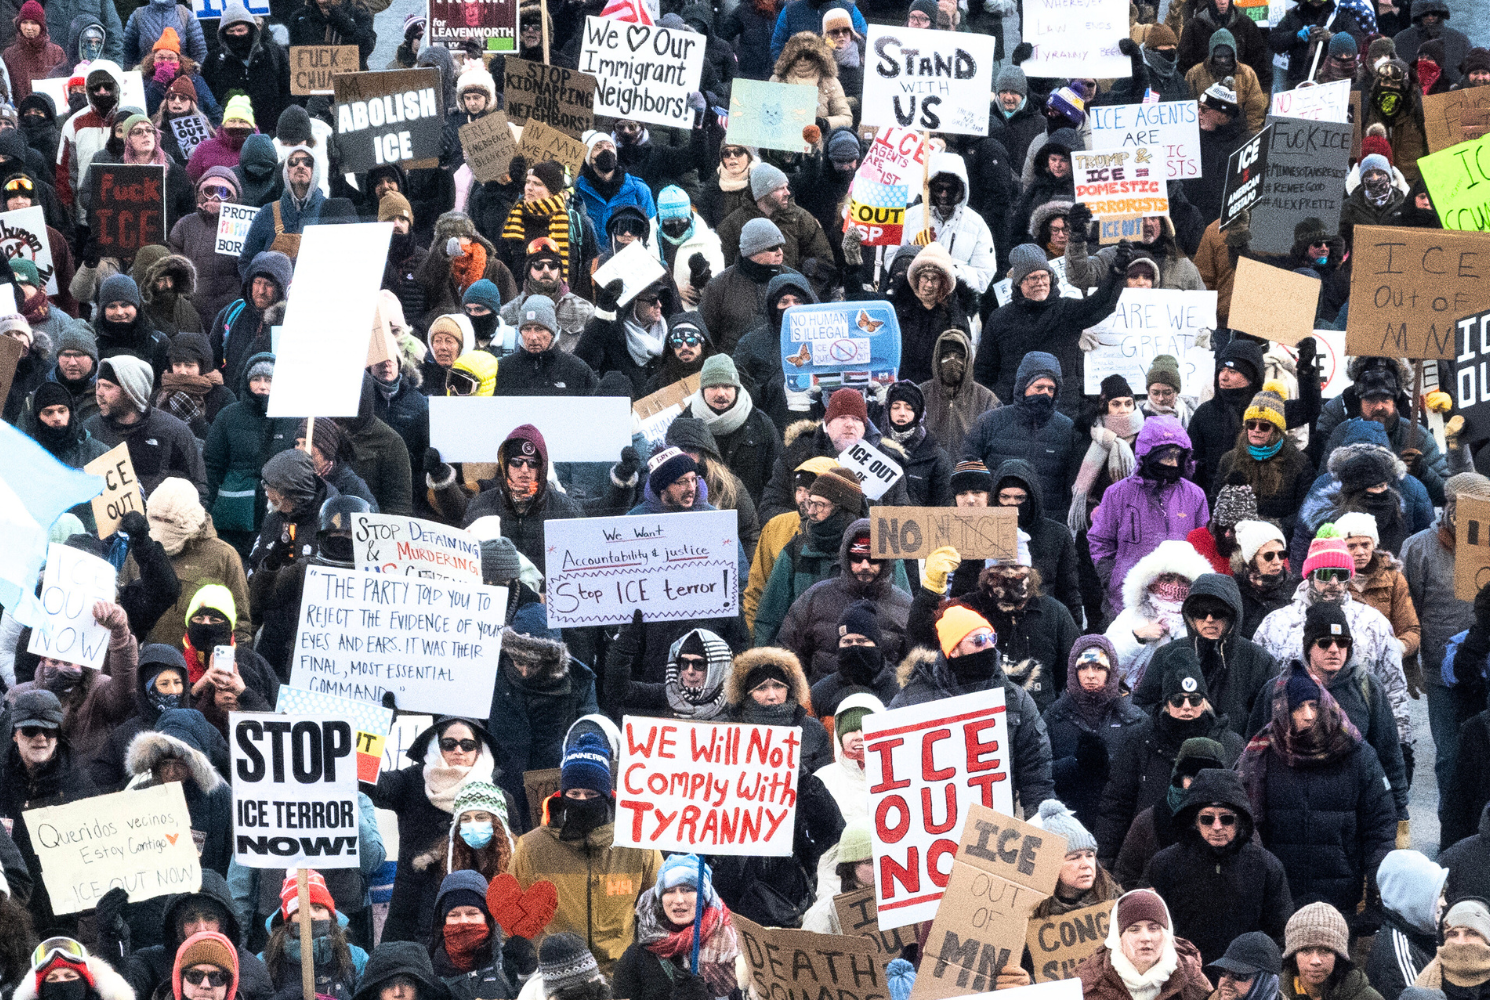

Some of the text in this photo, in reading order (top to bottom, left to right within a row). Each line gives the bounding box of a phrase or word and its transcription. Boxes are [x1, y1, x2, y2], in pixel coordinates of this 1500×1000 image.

[431, 27, 514, 38] LEAVENWORTH
[587, 17, 695, 60] We Our
[1085, 21, 1111, 30] ENDS
[297, 48, 340, 69] FUCK
[526, 63, 571, 84] STOP
[582, 50, 687, 86] Immigrant
[874, 36, 977, 80] STAND
[506, 73, 594, 109] KIDNAPPING
[535, 95, 561, 112] OUR
[594, 78, 691, 121] Neighbors!
[900, 81, 949, 95] WITH
[174, 115, 202, 129] ICE
[338, 87, 437, 133] ABOLISH
[893, 95, 943, 130] US
[1091, 103, 1196, 130] ICE AGENTS
[374, 131, 413, 164] ICE
[875, 127, 935, 165] ICE
[1123, 130, 1160, 146] ARE
[870, 143, 909, 168] AGENTS
[1075, 152, 1129, 170] TRUMP
[1134, 149, 1152, 164] &
[1237, 138, 1260, 173] ICE
[1076, 181, 1159, 197] DOMESTIC
[1228, 173, 1261, 206] AMERICAN
[1228, 189, 1257, 217] GESTAPO
[95, 209, 158, 249] ICE
[859, 207, 905, 223] OUT
[1102, 218, 1142, 238] ICE OUT
[1374, 243, 1480, 278] ICE
[790, 313, 847, 327] NO HUMAN
[1113, 302, 1199, 330] ARE WE
[791, 327, 848, 341] IS ILLEGAL
[1381, 323, 1452, 355] MN
[847, 444, 898, 483] ICE OUT
[107, 492, 135, 520] OUT
[356, 517, 480, 559] STOP DETAINING
[603, 525, 665, 542] We Want
[366, 540, 380, 561] &
[397, 541, 479, 576] MURDERING
[563, 549, 648, 572] Accountability
[664, 545, 710, 564] justice
[306, 604, 505, 640] REJECT THE EVIDENCE OF YOUR
[301, 632, 484, 660] EYES AND EARS. IT WAS THEIR
[301, 655, 455, 682] FINAL, MOST ESSENTIAL
[236, 719, 352, 785] STOP
[626, 722, 800, 769] WE Will Not
[867, 717, 1001, 794] ICE
[624, 762, 797, 808] Comply With
[237, 800, 354, 829] ICE TERROR
[875, 772, 1007, 844] OUT
[38, 812, 179, 849] Queridos vecinos,
[237, 835, 358, 857] NOW!
[79, 837, 167, 865] Estoy Contigo
[965, 818, 1043, 876] ICE
[971, 873, 1027, 909] OUT
[971, 907, 1005, 931] OF
[742, 930, 878, 988] DEATH
[933, 930, 1011, 992] MN
